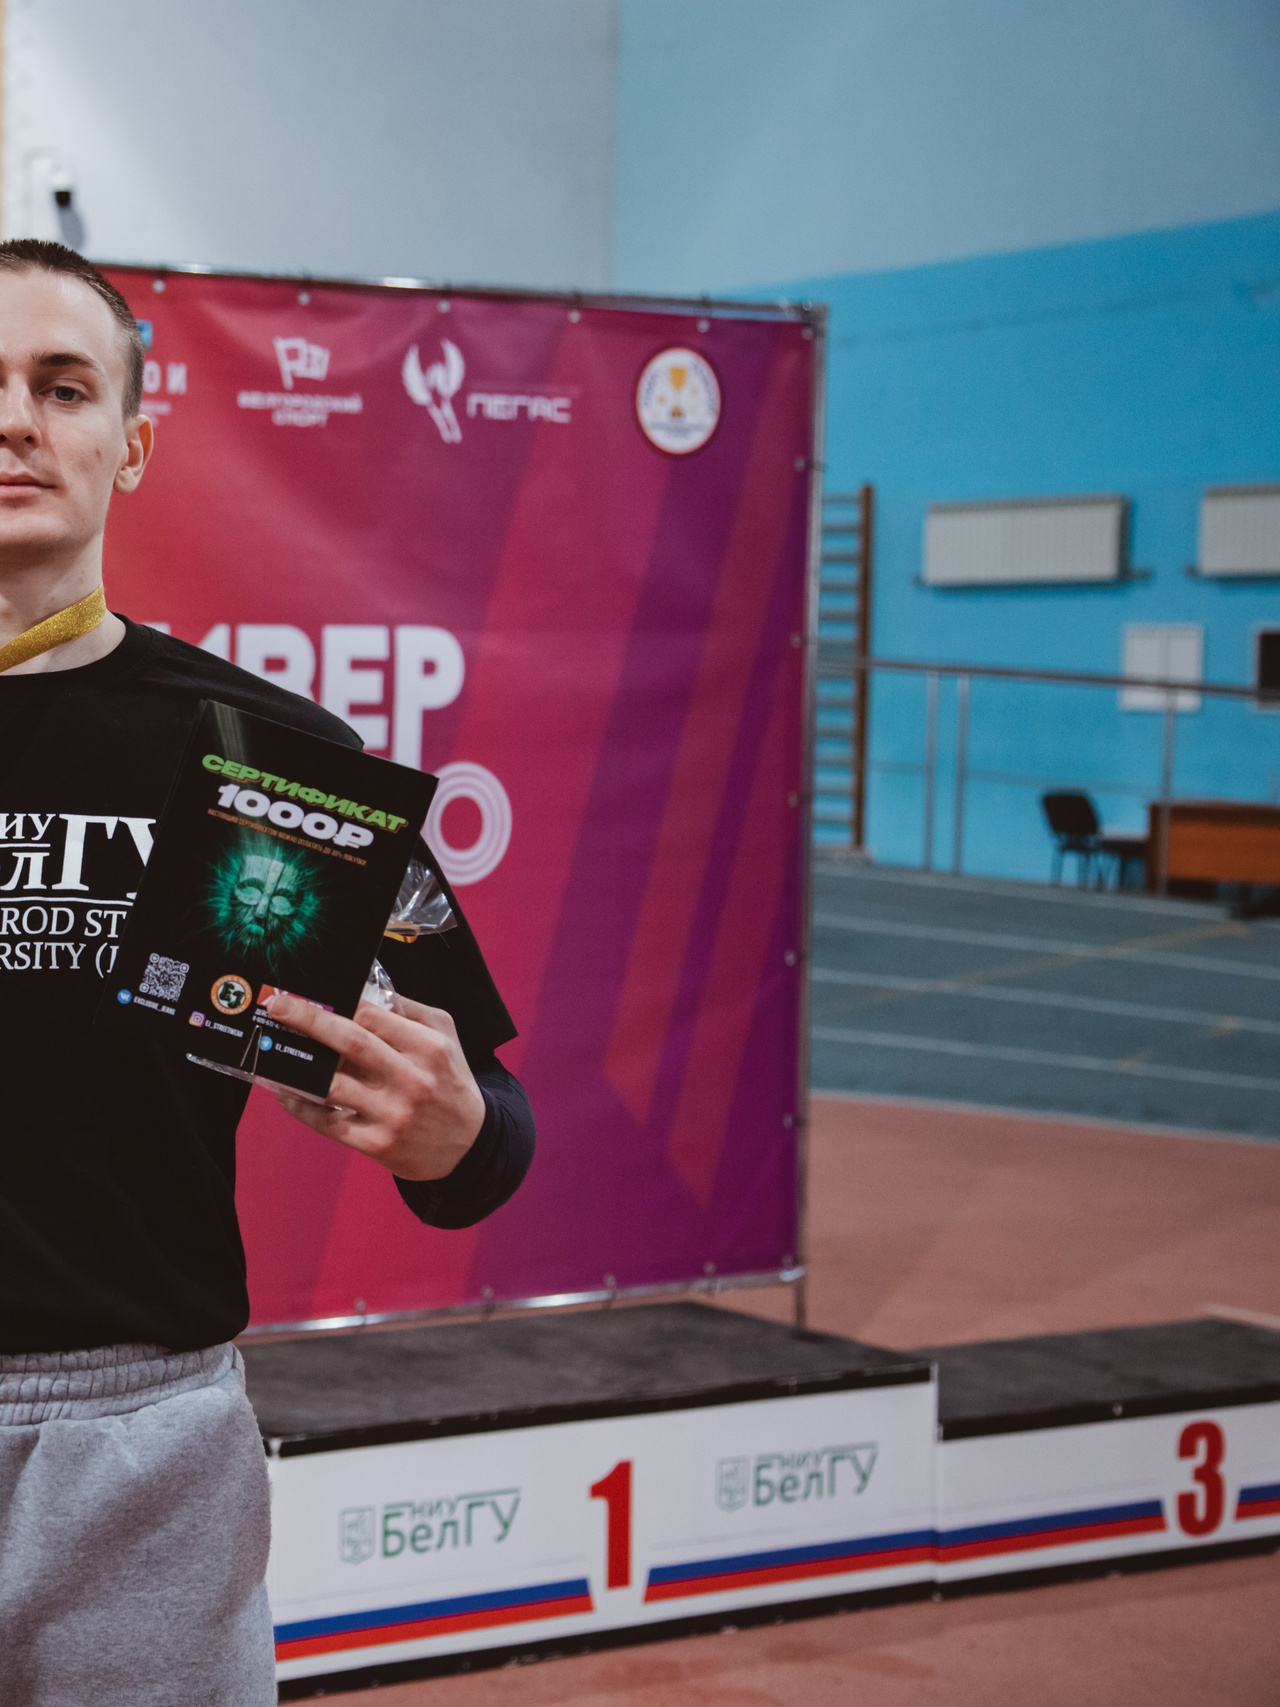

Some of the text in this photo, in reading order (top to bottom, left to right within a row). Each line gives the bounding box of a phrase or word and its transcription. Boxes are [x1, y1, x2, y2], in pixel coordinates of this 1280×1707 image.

[466, 392, 572, 423] ПЕГАС
[141, 622, 465, 770] ВЕР
[202, 754, 408, 833] СЕРТИФИКАТ
[753, 1452, 879, 1507] БелГУ
[1176, 1420, 1226, 1537] 3
[381, 1497, 521, 1558] БелГУ
[589, 1460, 634, 1590] 1
